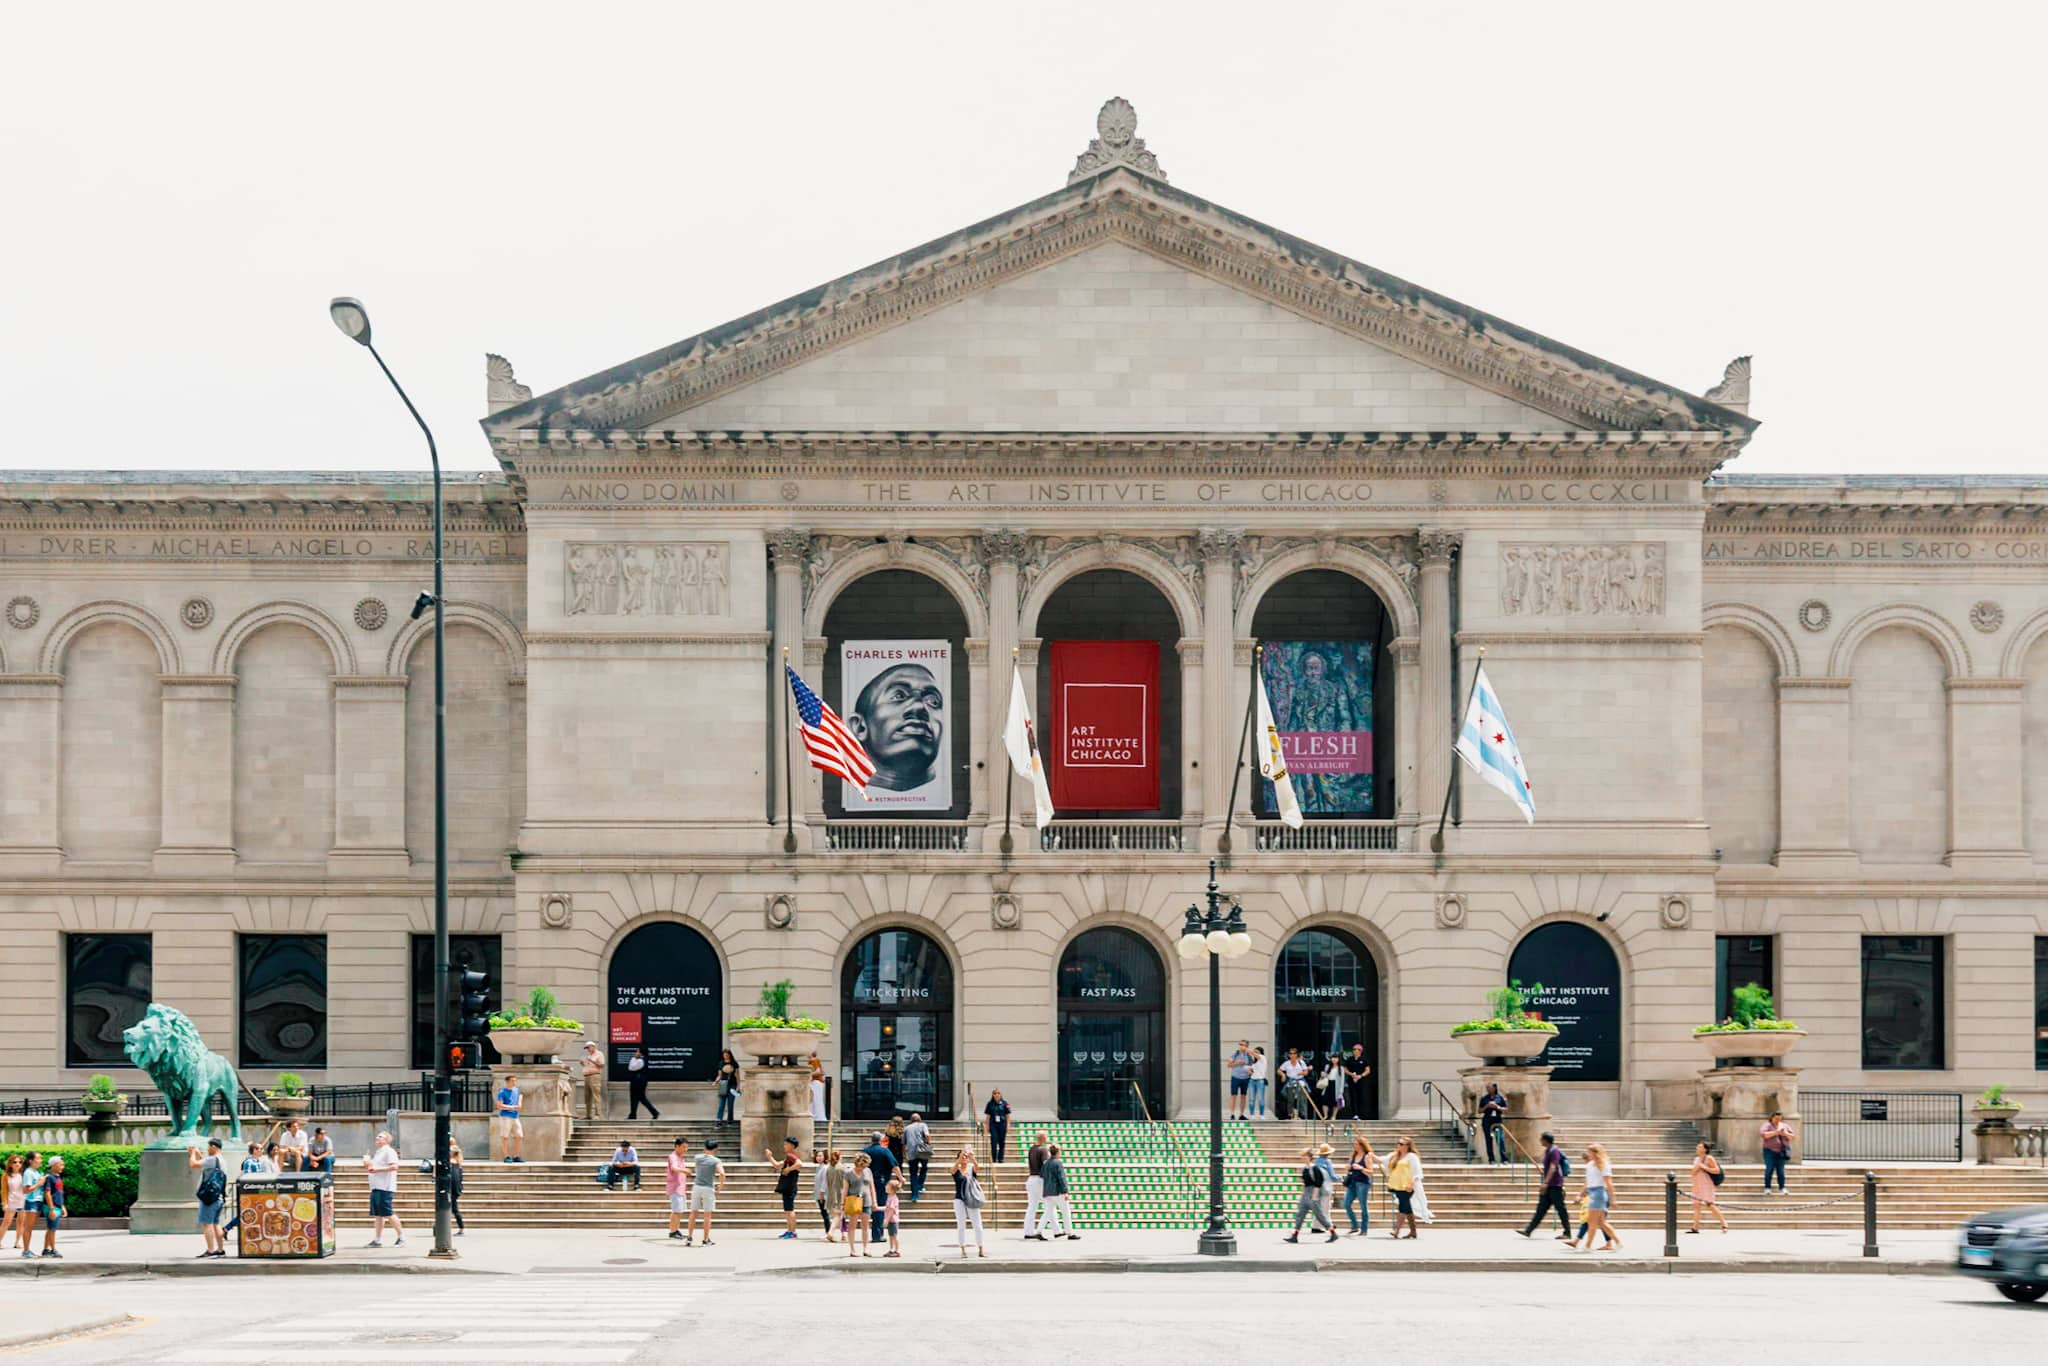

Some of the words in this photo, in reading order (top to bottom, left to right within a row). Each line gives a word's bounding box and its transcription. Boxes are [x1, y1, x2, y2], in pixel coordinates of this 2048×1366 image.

[561, 483, 629, 500] ANNO
[643, 483, 736, 500] DOMINI
[863, 483, 912, 500] THE
[949, 483, 998, 500] ART
[1029, 483, 1167, 500] INSTITVTE
[1197, 483, 1232, 501] OF
[1261, 483, 1373, 501] CHICAGO
[1496, 483, 1669, 501] MDCCCXCII
[40, 538, 117, 554] DVRER
[151, 538, 259, 555] MICHAEL
[271, 539, 373, 556] ANGELO
[1754, 541, 1840, 558] ANDREA
[1851, 541, 1892, 558] DEL
[1901, 542, 1972, 559] SARTO
[846, 650, 903, 660] CHARLES
[907, 649, 947, 659] WHITE
[1071, 726, 1096, 735] ART
[1071, 738, 1139, 748] INSTITVTE
[1280, 736, 1358, 755] FLESH
[1071, 749, 1132, 760] CHICAGO
[1309, 761, 1351, 769] ALBRIGHT
[617, 987, 636, 995] THE
[638, 987, 657, 995] ART
[660, 987, 710, 995] INSTITUTE
[865, 988, 929, 997] TICKETING
[1080, 988, 1107, 997] FAST
[1110, 988, 1136, 997] PASS
[1295, 987, 1348, 997] MEMBERS
[1539, 987, 1557, 995] ART
[1560, 987, 1610, 995] INSTITUTE
[617, 997, 630, 1005] OF
[632, 997, 677, 1005] CHICAGO
[1532, 997, 1577, 1005] CHICAGO
